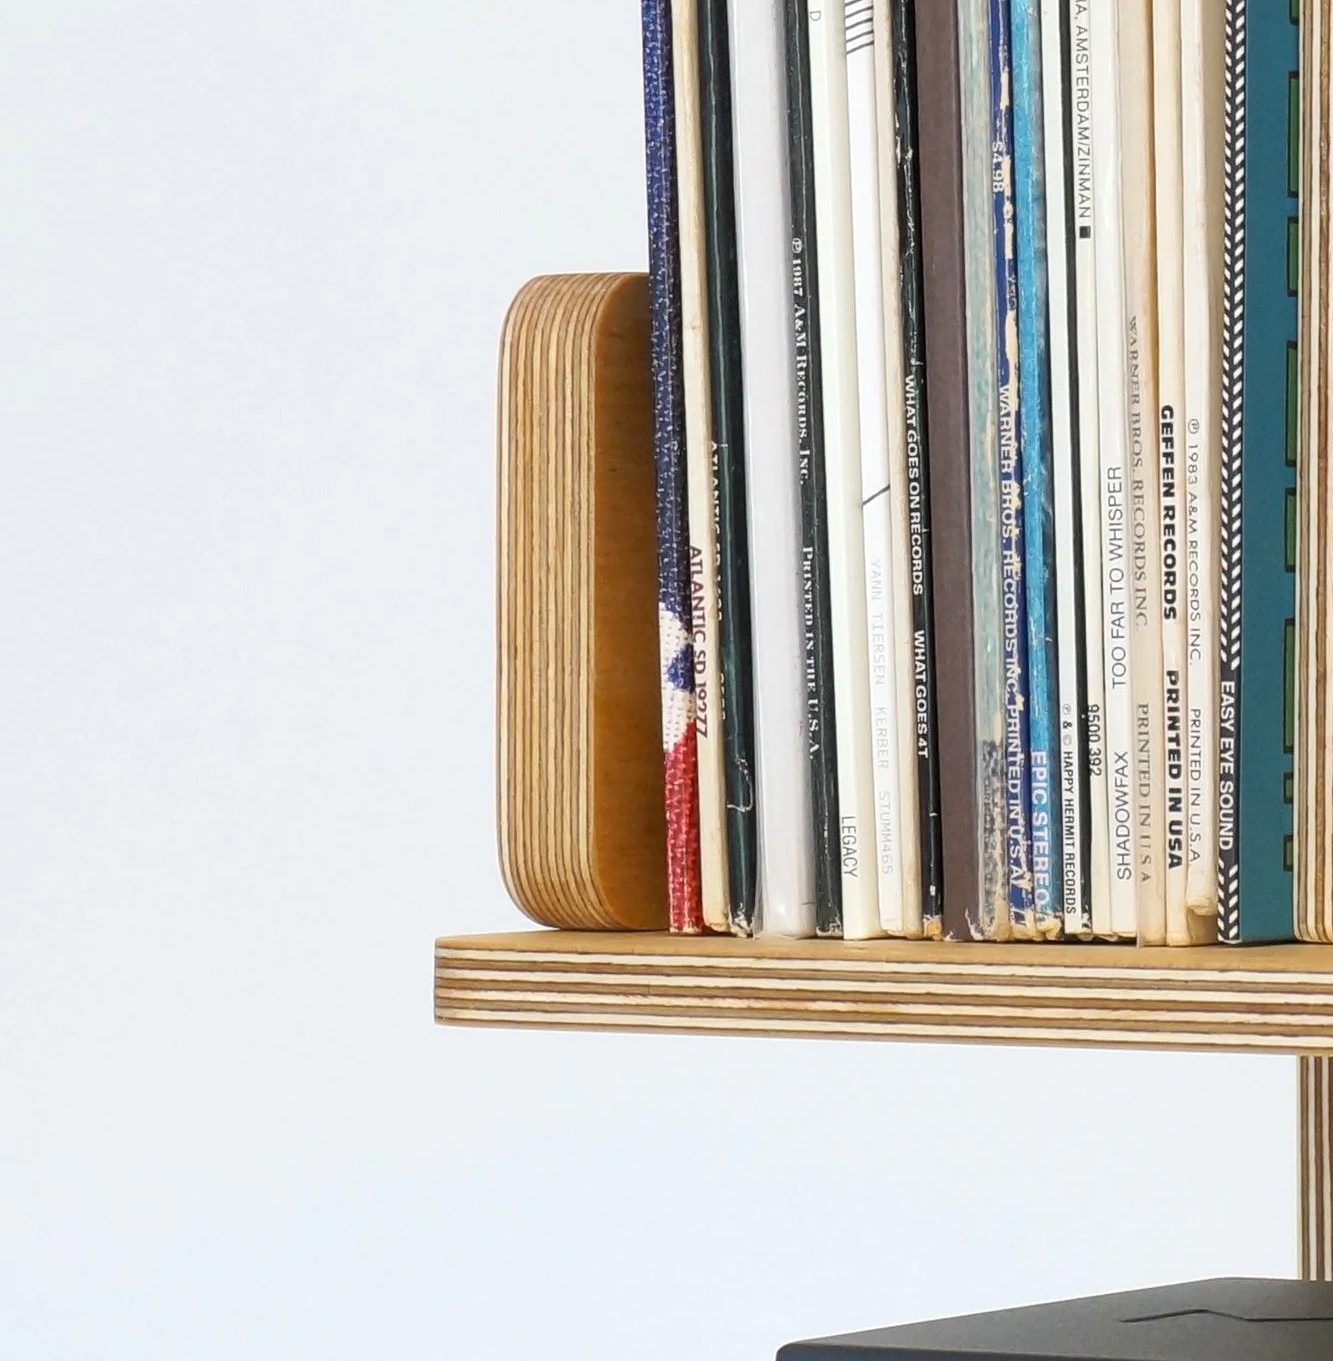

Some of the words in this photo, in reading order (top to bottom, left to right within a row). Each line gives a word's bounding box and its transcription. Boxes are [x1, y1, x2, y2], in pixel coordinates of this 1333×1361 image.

[1074, 24, 1091, 219] AMSTERDAM/ZINMAN
[991, 140, 1005, 193] $4.98
[904, 375, 919, 425] WHAT
[906, 429, 921, 478] GOES
[1130, 412, 1144, 473] BROS.
[1161, 405, 1176, 499] GEFFEN
[1187, 443, 1200, 485] 1983
[909, 481, 922, 509] ON
[1107, 466, 1124, 559] WHISPER
[1188, 491, 1200, 535] A&M
[910, 511, 925, 596] RECORDS
[1132, 480, 1146, 583] RECORDS
[1110, 564, 1124, 594] TO
[1162, 504, 1178, 620] RECORDS
[1188, 540, 1201, 623] RECORDS
[689, 545, 706, 643] ATLANTIC
[1111, 601, 1125, 642] FAR
[692, 648, 707, 677] SD
[913, 629, 927, 681] WHAT
[1112, 647, 1126, 689] TOO
[915, 684, 928, 734] GOES
[1087, 703, 1101, 743] 9500
[1165, 669, 1182, 780] PRINTED
[1219, 681, 1235, 731] EASY
[916, 738, 928, 758] 4T
[1088, 748, 1102, 777] 392
[1135, 702, 1150, 797] PRINTED
[1189, 708, 1202, 783] PRINTED
[1219, 737, 1235, 775] EYE
[1031, 750, 1049, 807] EPIC
[1063, 751, 1075, 793] HAPPY
[1189, 787, 1202, 807] IN
[1064, 798, 1076, 848] HERMIT
[1114, 751, 1132, 880] SHADOWFAX
[1137, 801, 1151, 828] IN
[1167, 786, 1182, 814] IN
[1219, 780, 1234, 850] SOUND
[840, 816, 858, 878] LEGACY
[1032, 811, 1051, 906] STEREO
[1166, 819, 1183, 869] USA
[1064, 853, 1079, 915] RECORDS
